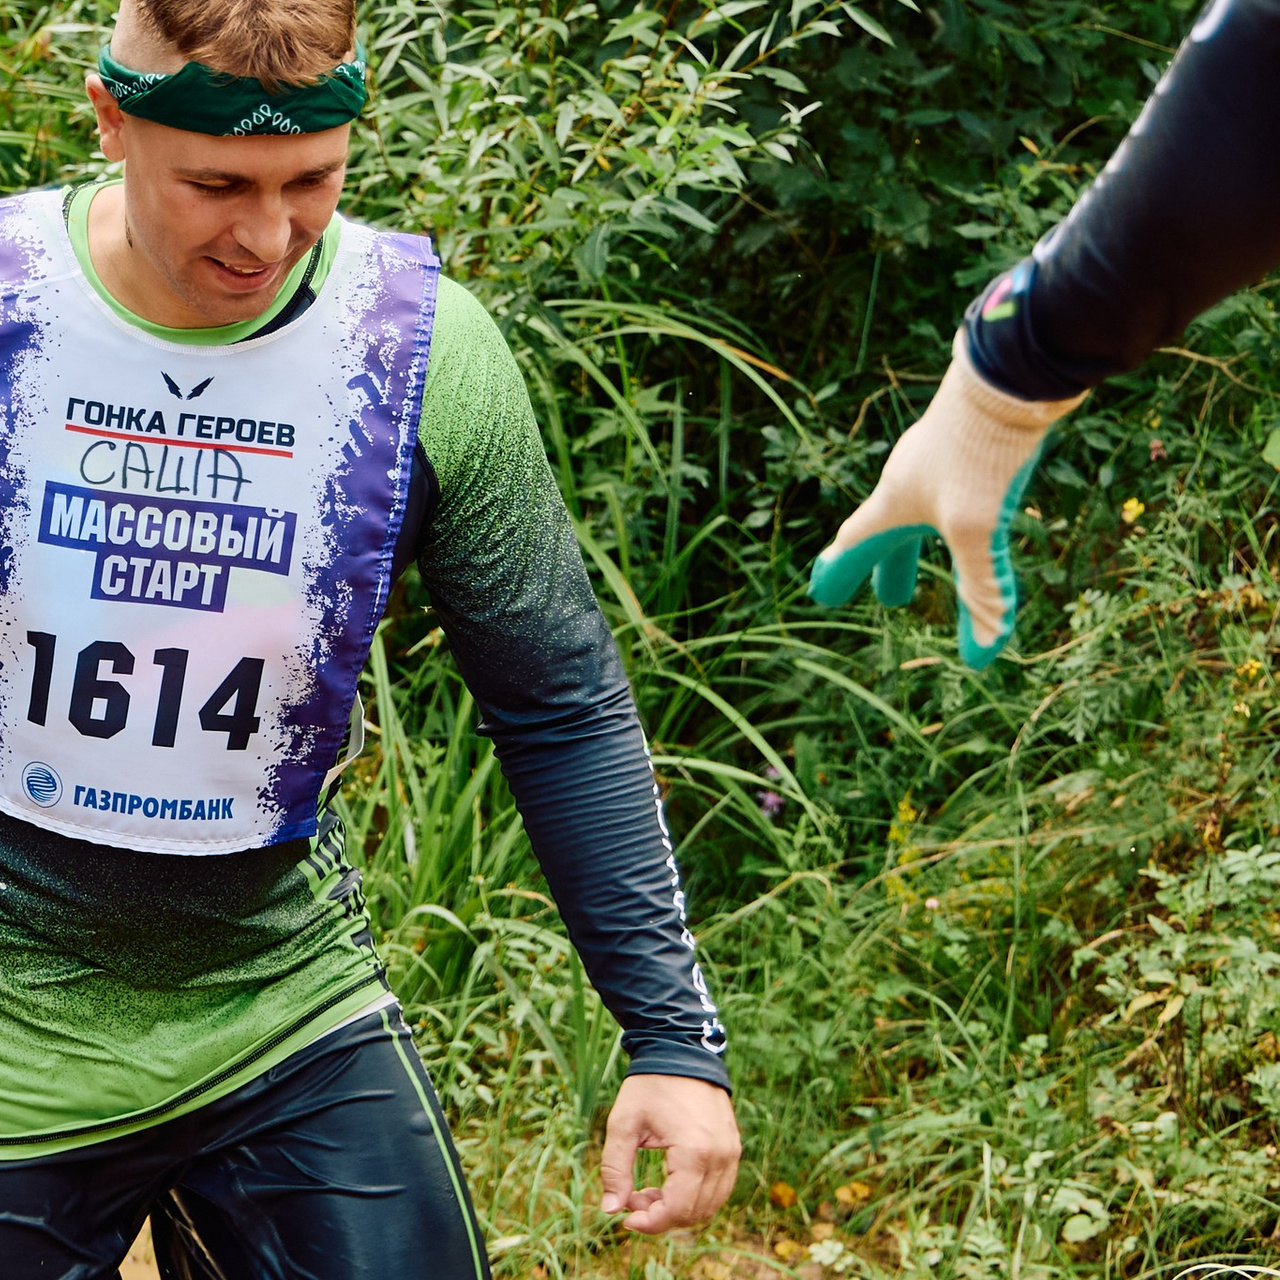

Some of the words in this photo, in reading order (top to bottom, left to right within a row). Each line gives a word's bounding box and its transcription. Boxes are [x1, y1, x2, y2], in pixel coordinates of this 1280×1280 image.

[65, 397, 167, 435] ГОНКА
[177, 412, 296, 448] ГЕРОЕВ
[48, 492, 287, 565] МАССОВЫЙ
[99, 554, 223, 606] СТАРТ
[26, 629, 266, 751] 1614
[73, 784, 235, 821] ГАЗПРОМБАНК
